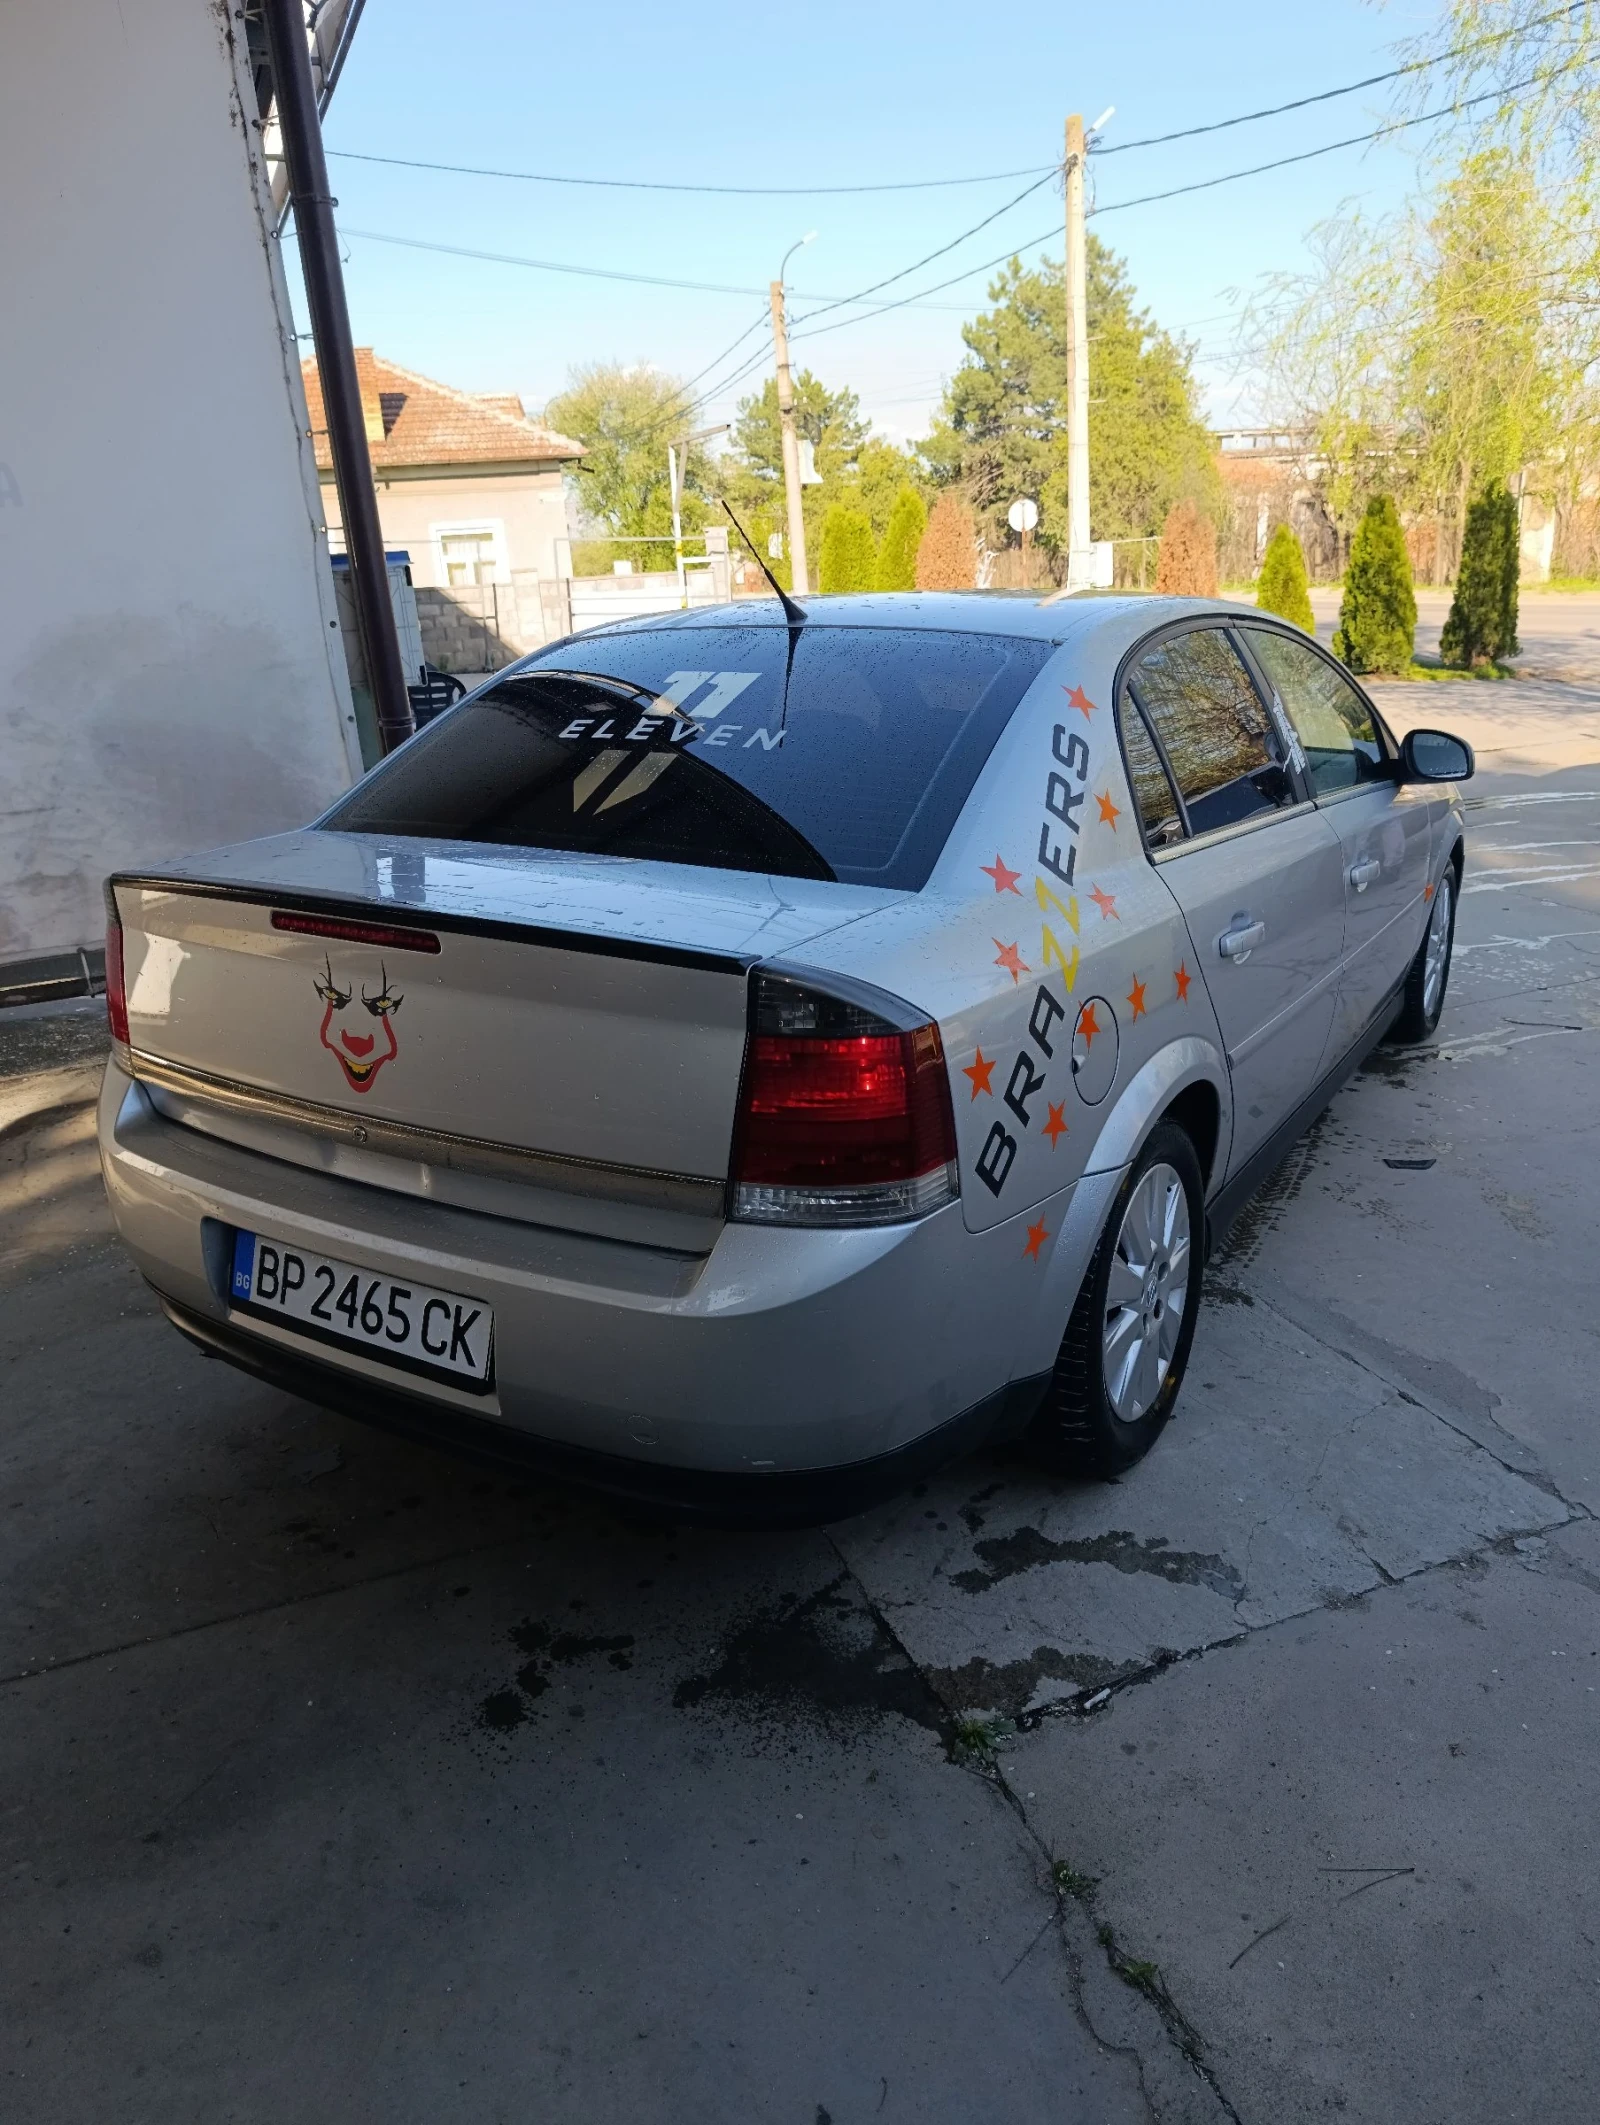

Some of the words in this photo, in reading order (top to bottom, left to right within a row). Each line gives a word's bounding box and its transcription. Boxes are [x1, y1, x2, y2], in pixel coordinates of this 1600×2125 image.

[558, 719, 788, 751] ELEVEN
[974, 723, 1090, 1199] BRAZZERS
[235, 1271, 250, 1290] BG
[256, 1244, 305, 1305] BP
[310, 1265, 411, 1343] 2465
[420, 1298, 481, 1368] CK
